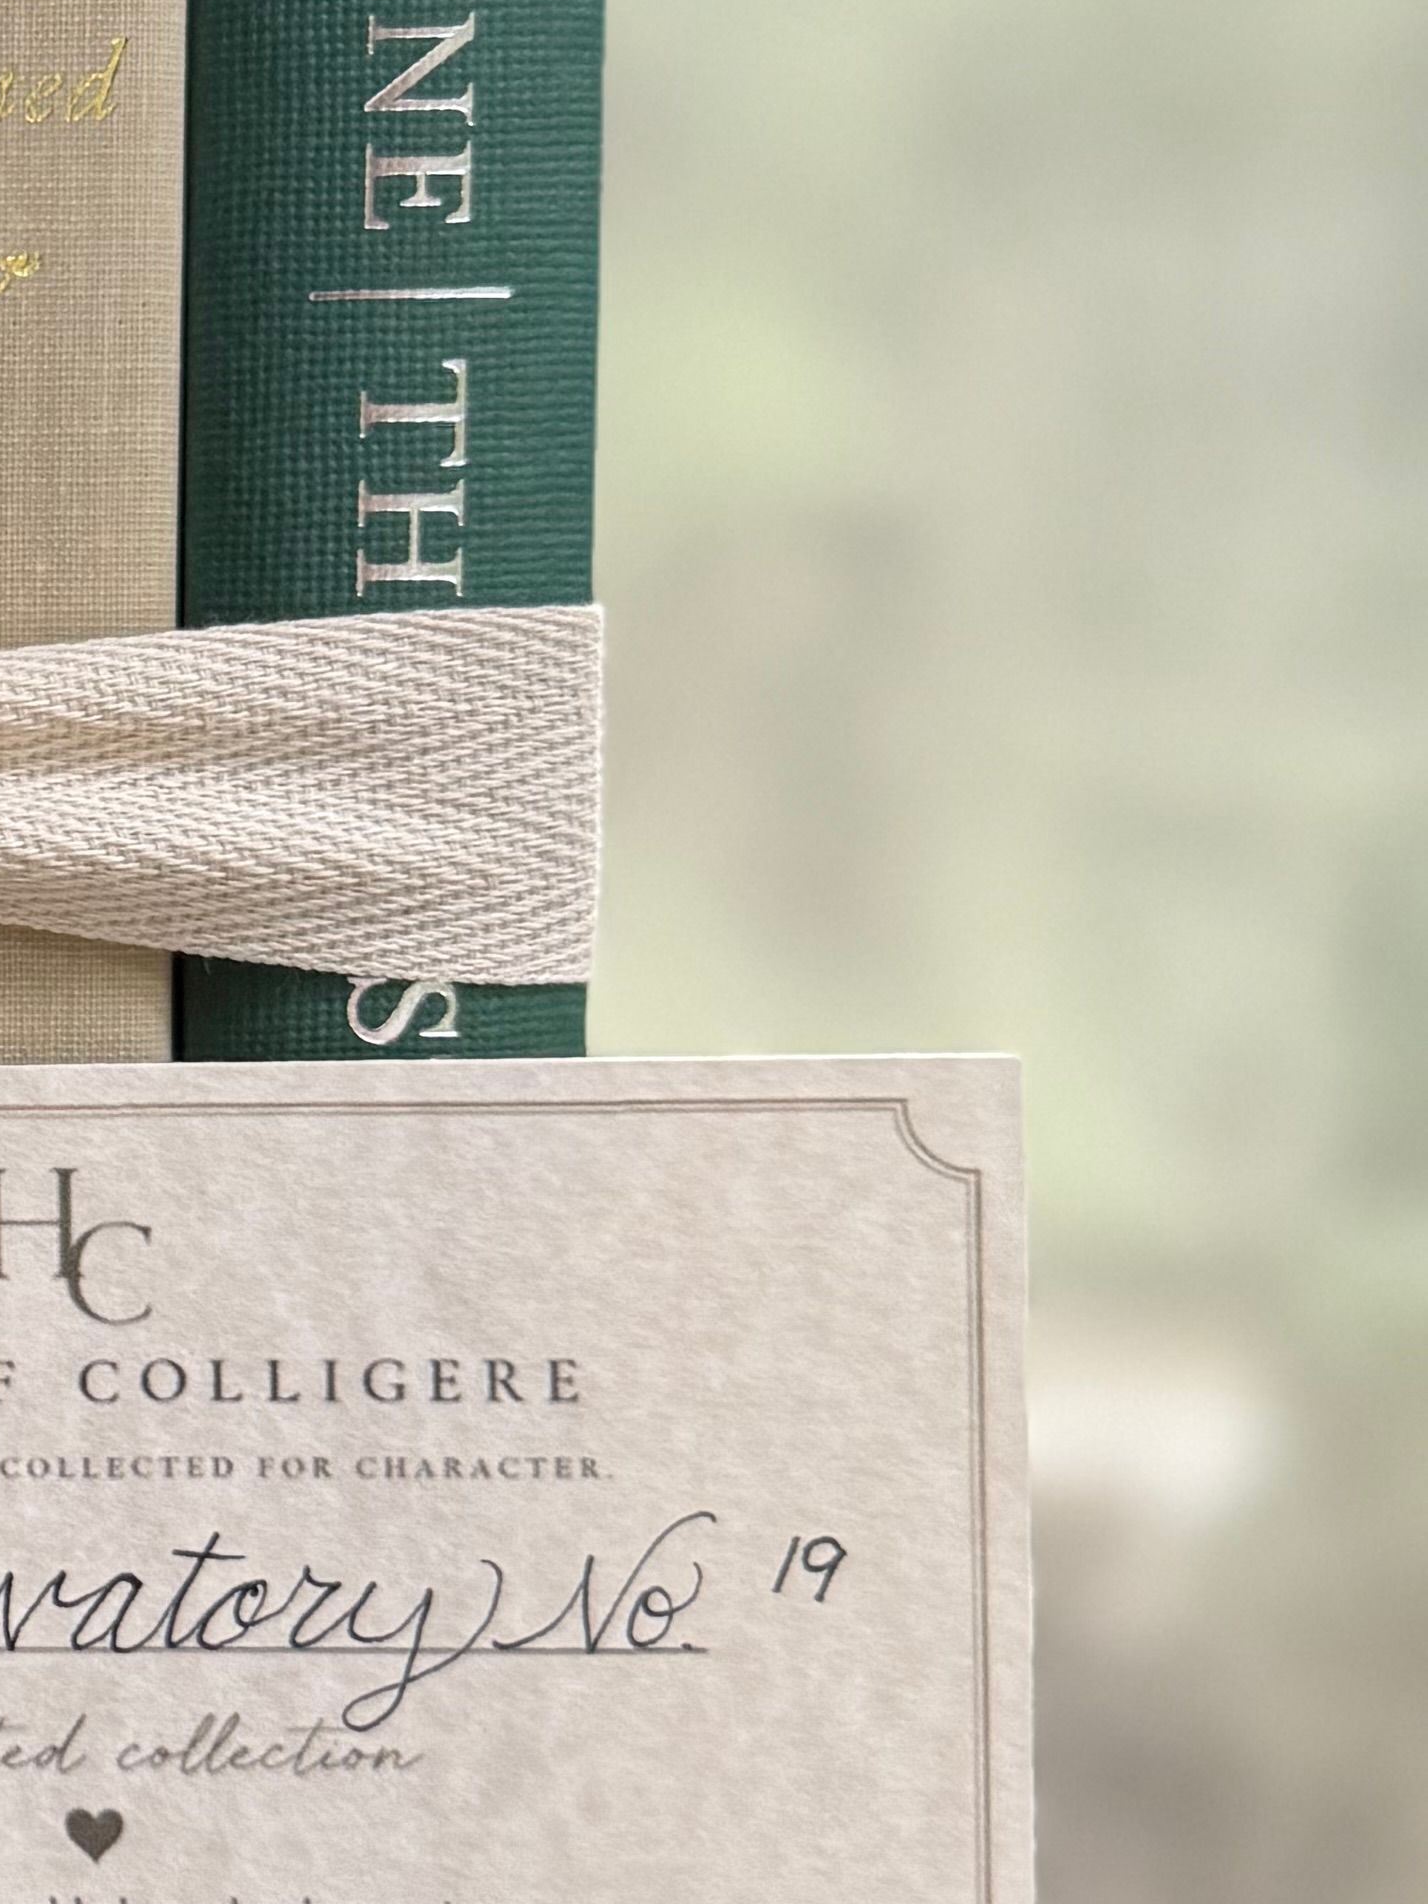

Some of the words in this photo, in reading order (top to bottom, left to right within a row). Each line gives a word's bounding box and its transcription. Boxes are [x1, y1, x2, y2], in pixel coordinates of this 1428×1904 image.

[355, 358, 469, 597] TH
[77, 1356, 582, 1408] COLLIGERE
[257, 1455, 334, 1481] FOR
[353, 1455, 615, 1482] CHARACTER.
[771, 1534, 848, 1604] 19
[115, 1712, 424, 1779] collection
